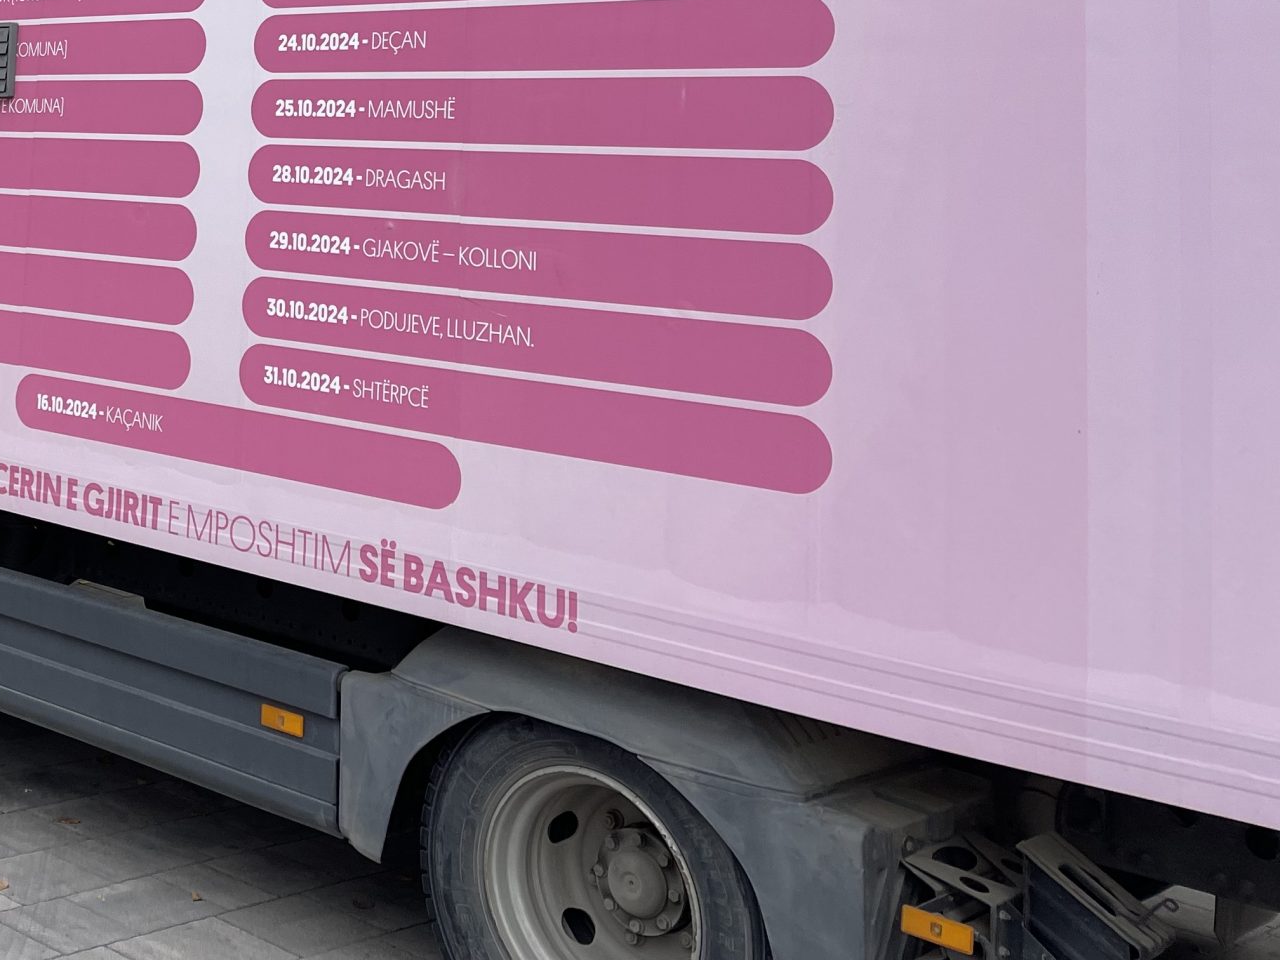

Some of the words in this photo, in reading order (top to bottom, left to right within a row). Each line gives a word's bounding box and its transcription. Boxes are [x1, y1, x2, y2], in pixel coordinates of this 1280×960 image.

[278, 33, 359, 51] 24.10.2024
[372, 31, 426, 55] DEÇAN
[9, 97, 64, 116] KOMUNA]
[275, 99, 356, 117] 25.10.2024
[368, 97, 455, 119] MAMUSHË
[272, 165, 353, 186] 28.10.2024
[366, 169, 445, 190] DRAGASH
[270, 231, 351, 254] 29.10.2024
[363, 238, 439, 262] GJAKOVË
[459, 246, 536, 271] KOLLONI
[267, 298, 348, 324] 30.10.2024
[361, 309, 443, 339] PODUJEVE,
[447, 318, 534, 347] LLUZHAN.
[264, 366, 341, 394] 31.10.2024
[353, 379, 428, 408] SHTËRPCË
[37, 394, 97, 419] 16.10.2024
[106, 406, 163, 432] KAÇANIK
[66, 477, 78, 511] E
[83, 482, 163, 530] GJIRIT
[168, 500, 180, 535] E
[186, 504, 351, 577] MPOSHTIM
[357, 538, 397, 588] SË
[403, 553, 577, 633] BASHKU!
